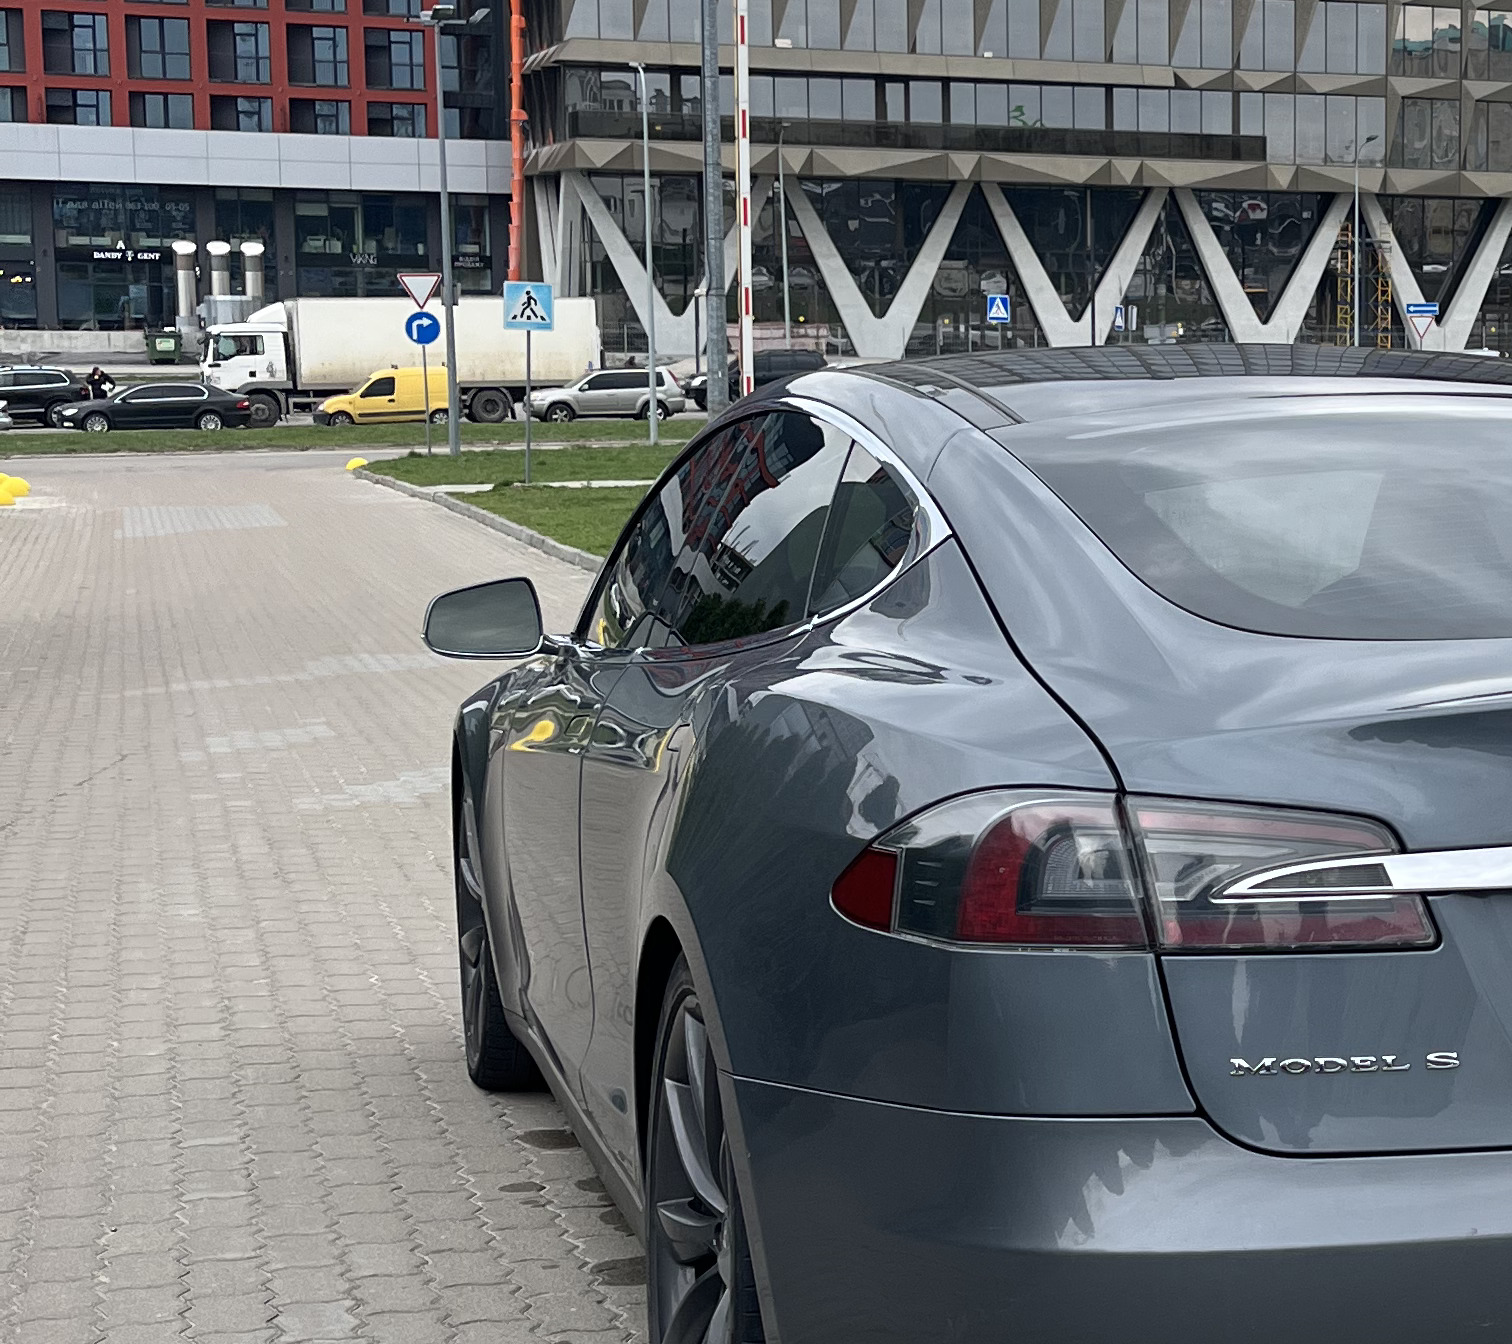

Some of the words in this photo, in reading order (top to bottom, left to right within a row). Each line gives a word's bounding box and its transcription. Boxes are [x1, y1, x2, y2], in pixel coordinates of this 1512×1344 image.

[137, 252, 161, 260] GENT
[1228, 1055, 1411, 1076] MODEL
[1425, 1051, 1460, 1070] S
